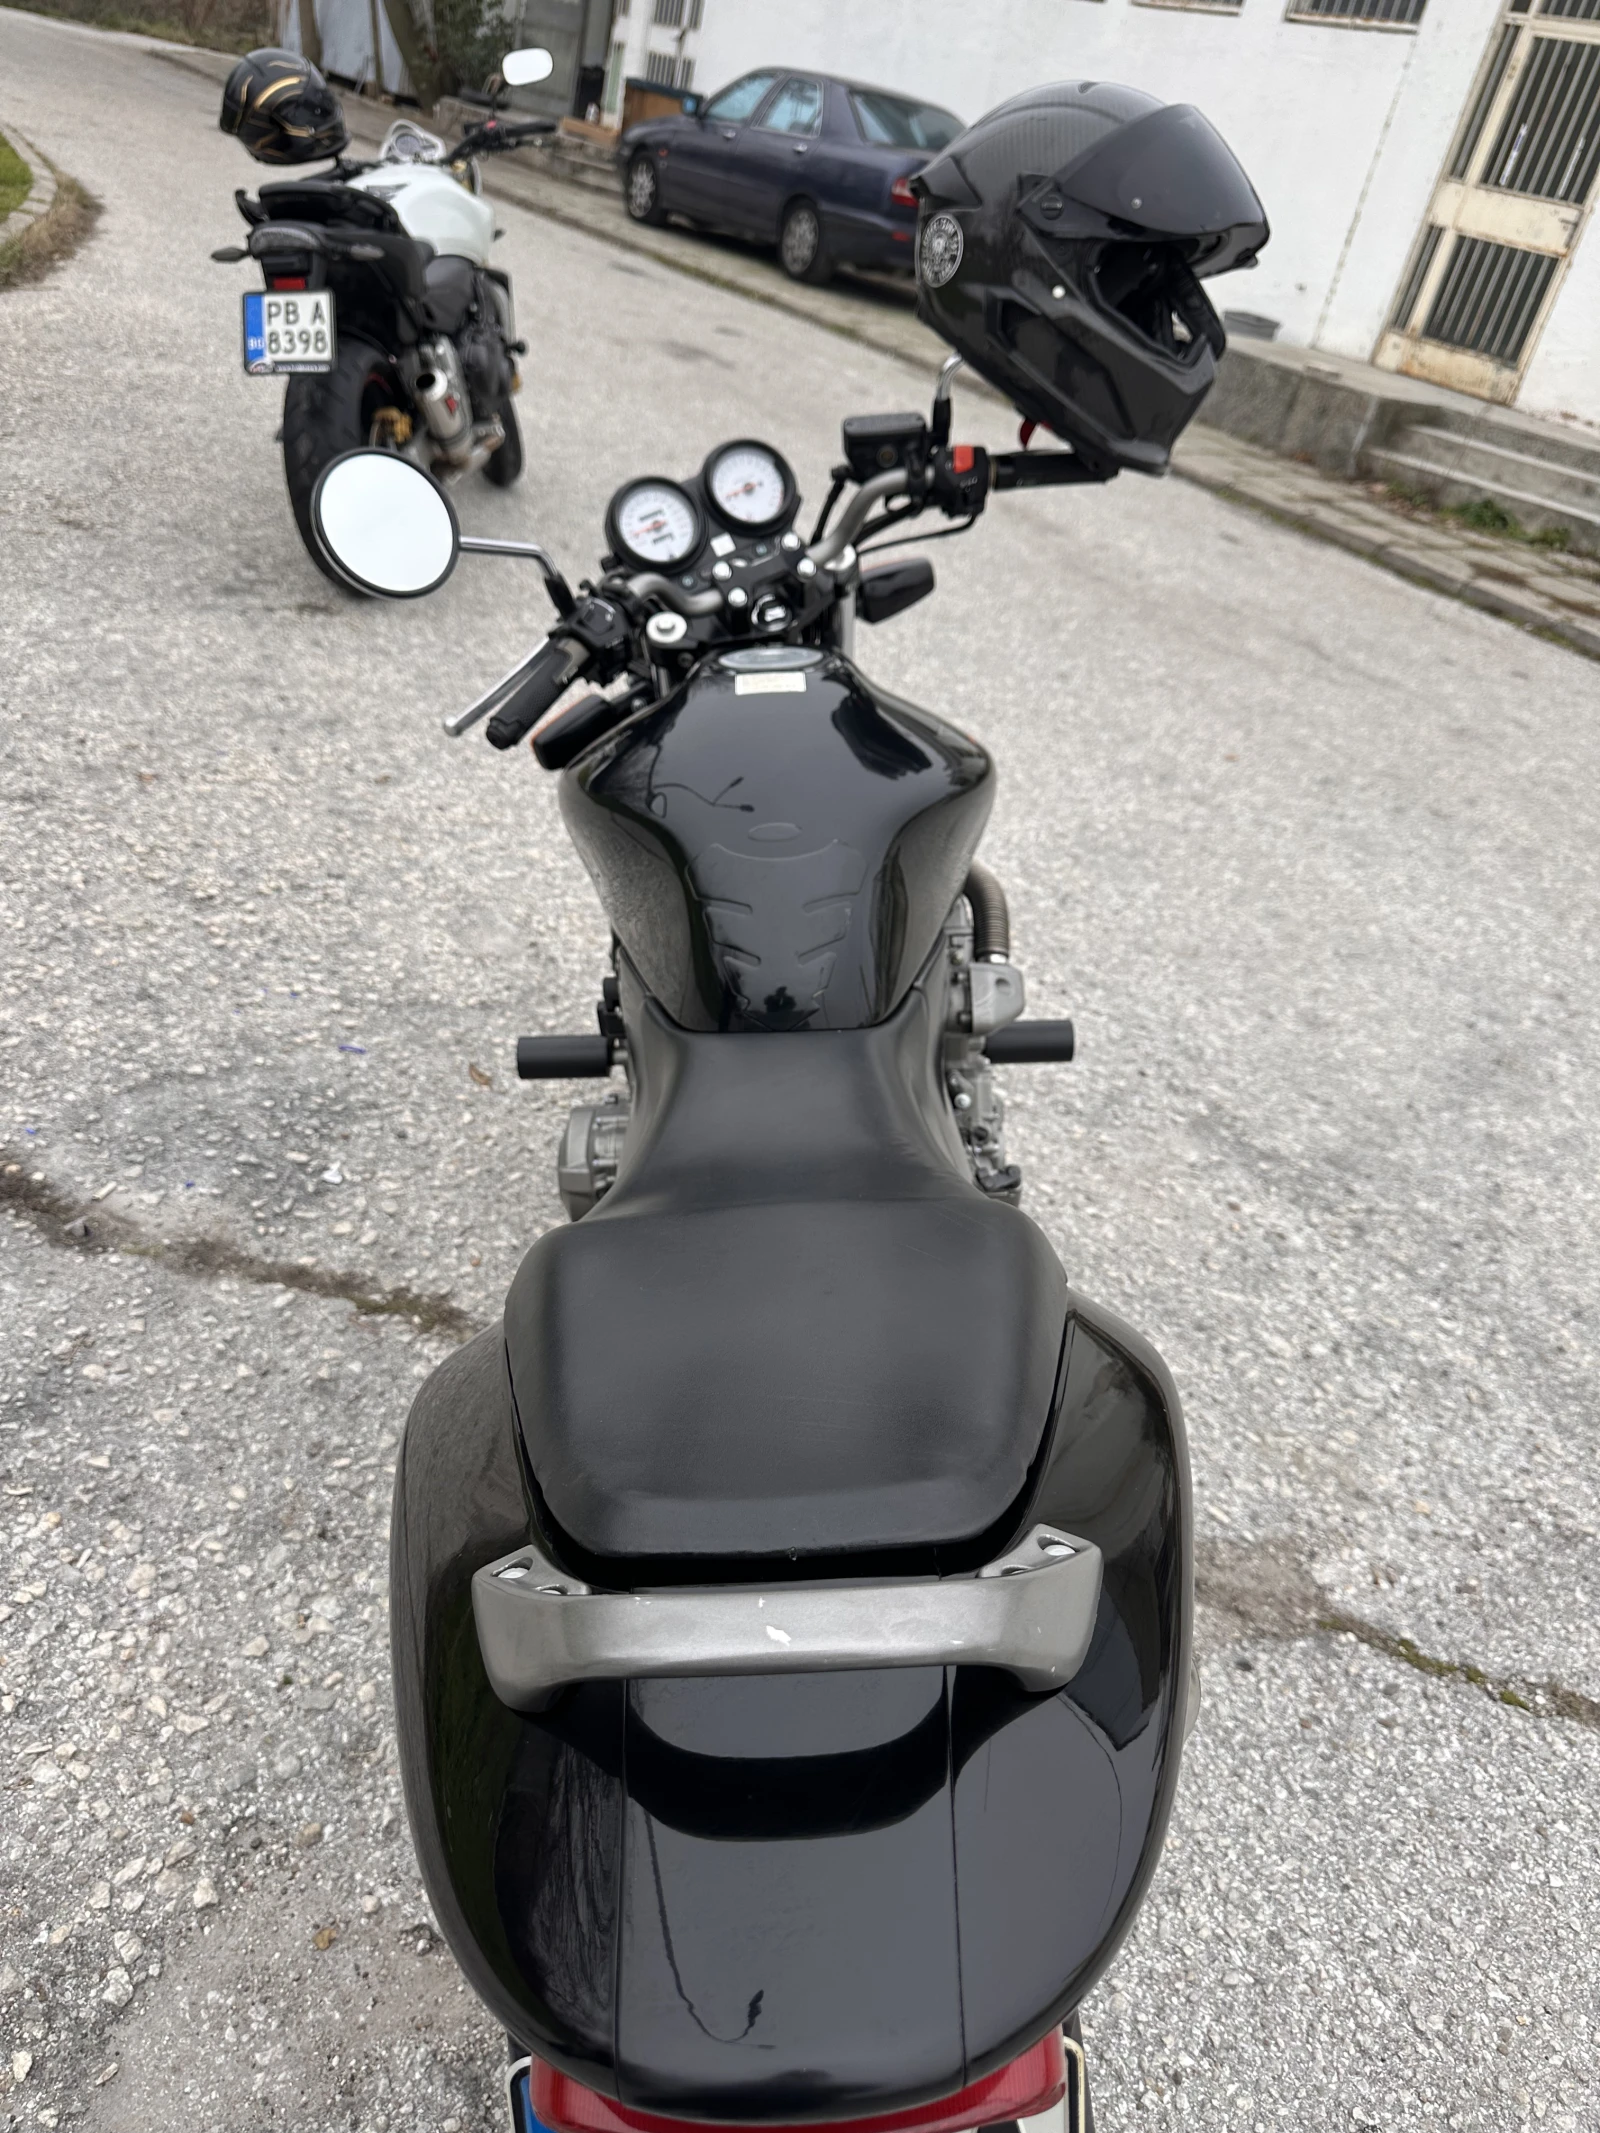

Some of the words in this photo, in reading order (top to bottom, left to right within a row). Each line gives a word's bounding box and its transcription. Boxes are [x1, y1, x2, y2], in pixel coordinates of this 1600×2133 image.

[267, 301, 299, 325] PB
[311, 301, 325, 325] A
[268, 329, 327, 354] 8398
